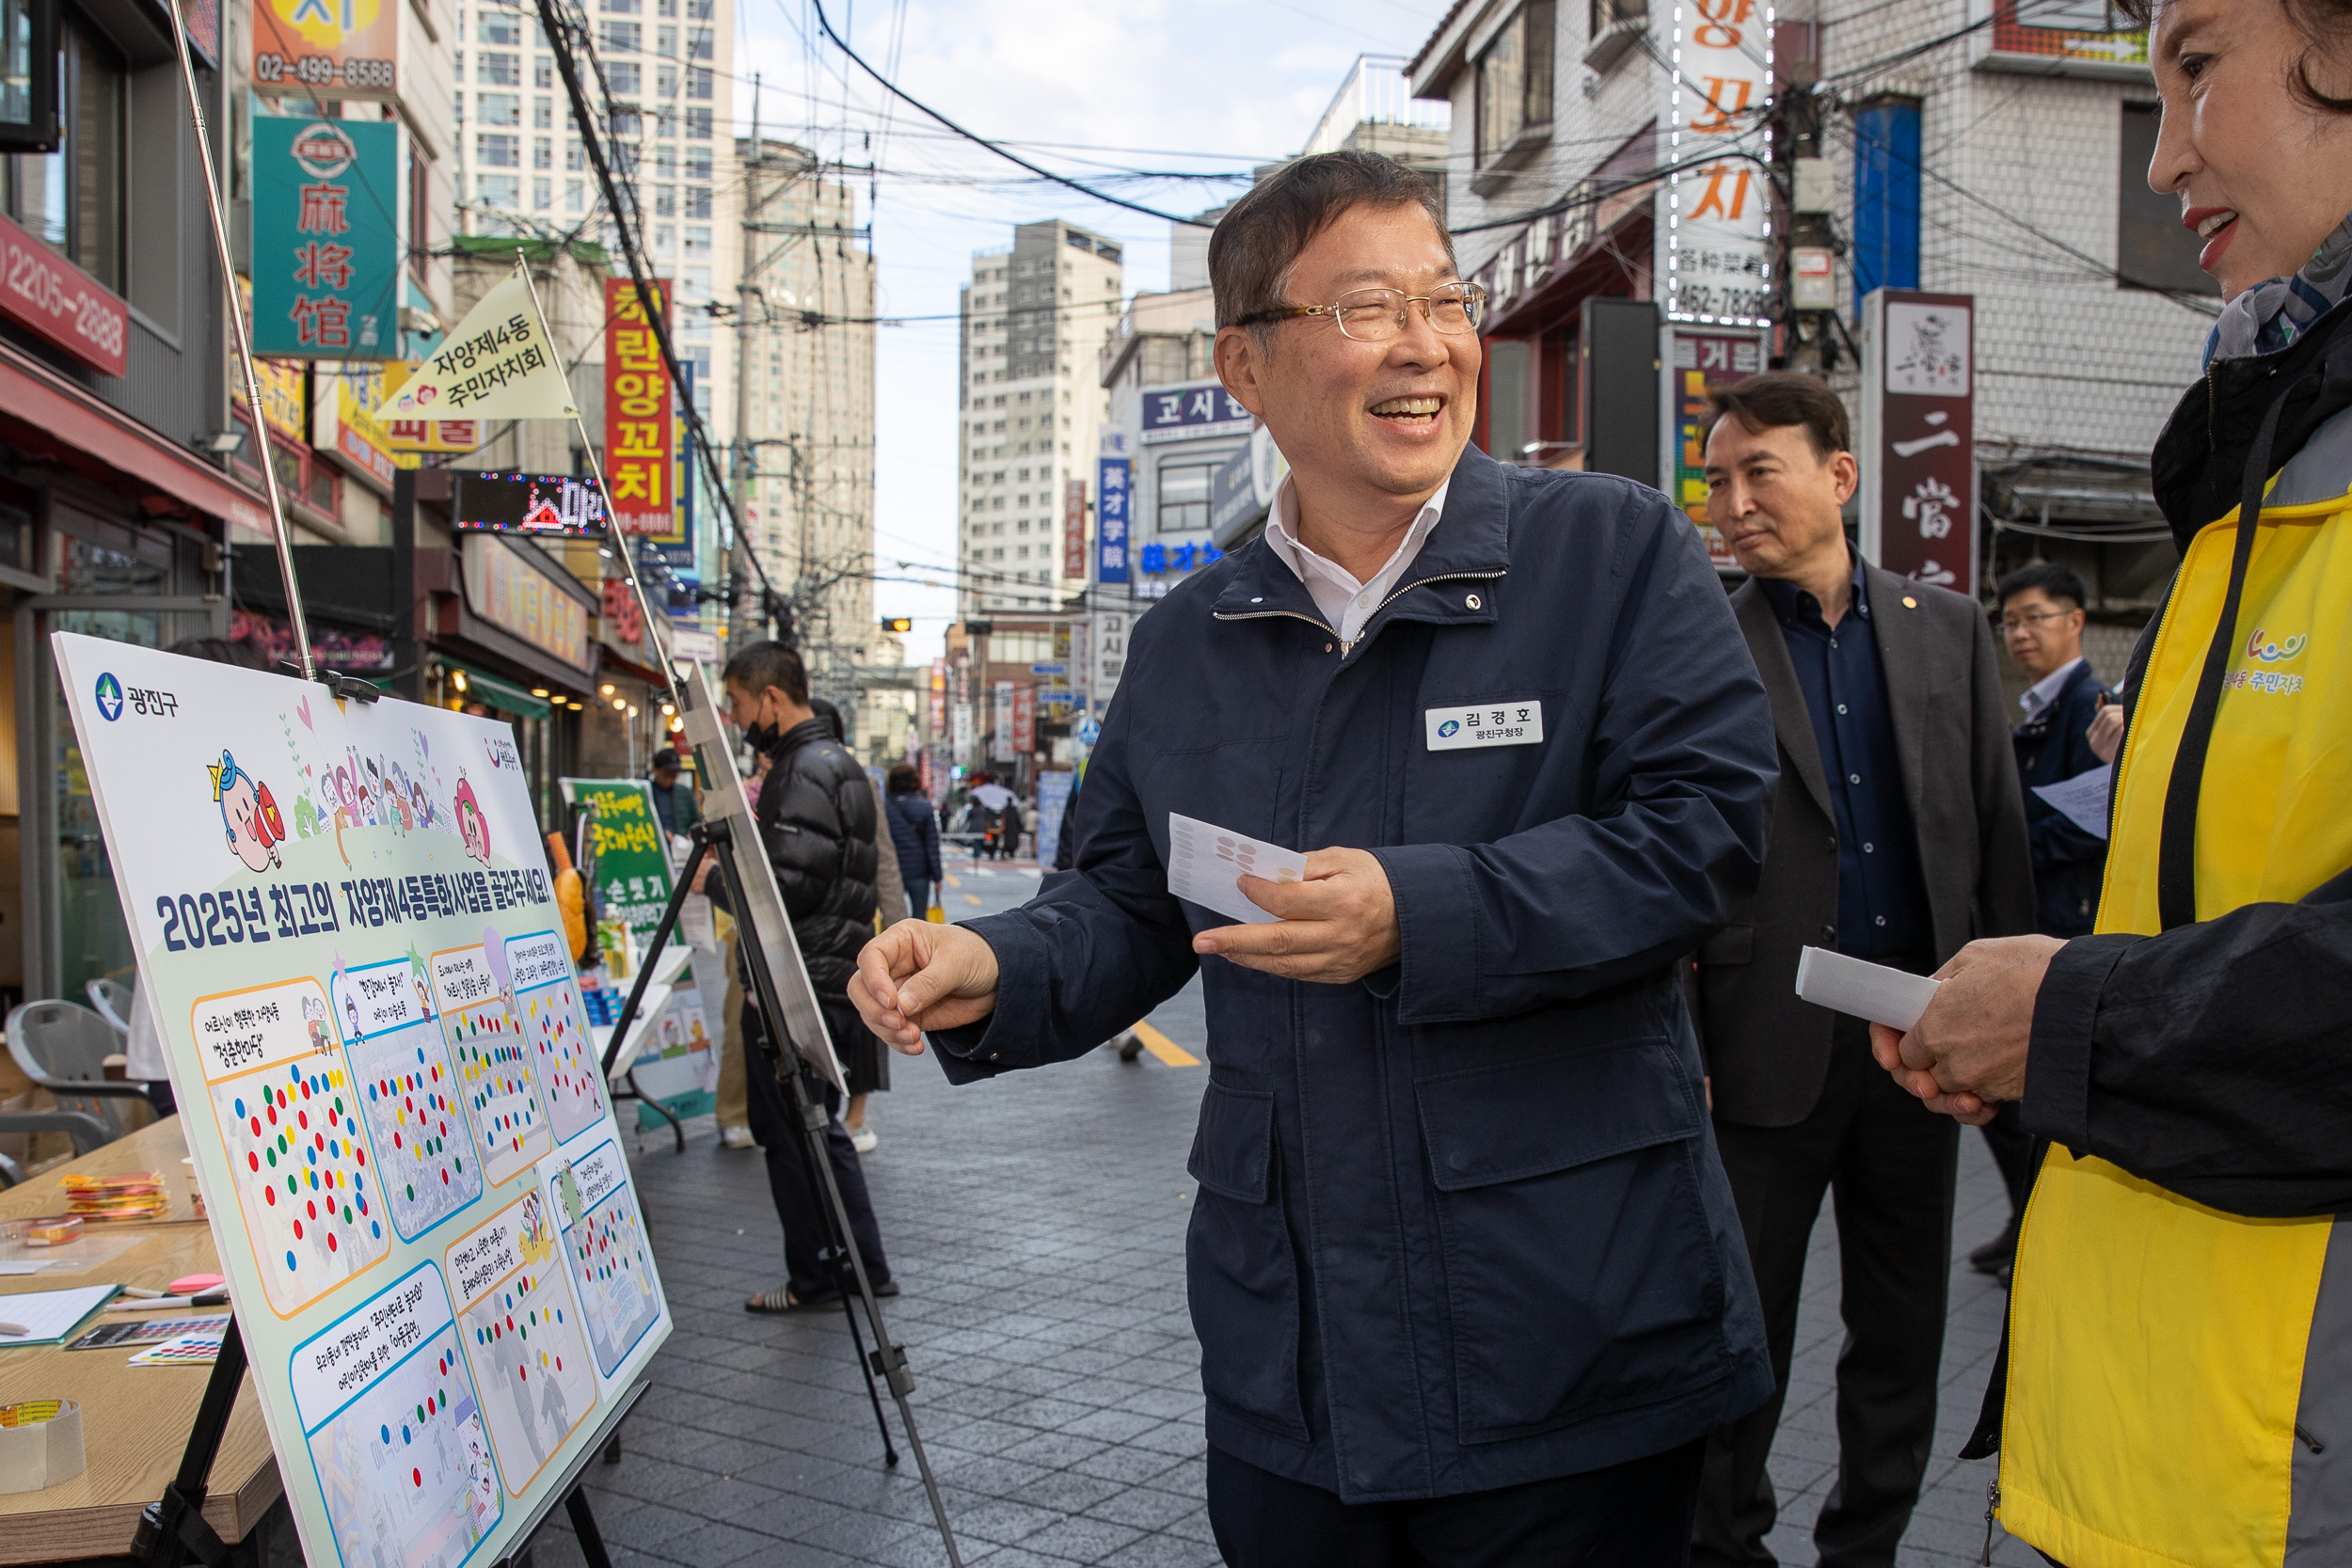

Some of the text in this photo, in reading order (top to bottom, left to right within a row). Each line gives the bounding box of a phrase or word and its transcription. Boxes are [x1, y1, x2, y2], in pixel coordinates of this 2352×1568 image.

[257, 53, 395, 88] 02-499-8588
[288, 181, 356, 349] 麻将馆
[434, 313, 530, 375] 자양제4동
[448, 344, 546, 408] 주민자치회
[127, 687, 179, 718] 광진구
[1475, 727, 1524, 740] 광진구청장
[156, 868, 551, 952] 2025년 최고의 자양제4동특화사업을 골라주세요!
[204, 1015, 233, 1034] 어르신이
[233, 1007, 256, 1030] 행복한
[373, 1000, 406, 1023] 어린이 미술소풍
[213, 1033, 264, 1069] "청춘한마당"
[454, 1225, 508, 1274] 안전하고 시원한 여름나기
[493, 1246, 514, 1272] 지원사업
[315, 1281, 423, 1373] 우리동네 깜짝놀이터 "주민센터로 놀러와"
[338, 1351, 378, 1390] 어린이집원아를
[376, 1343, 390, 1364] 위한
